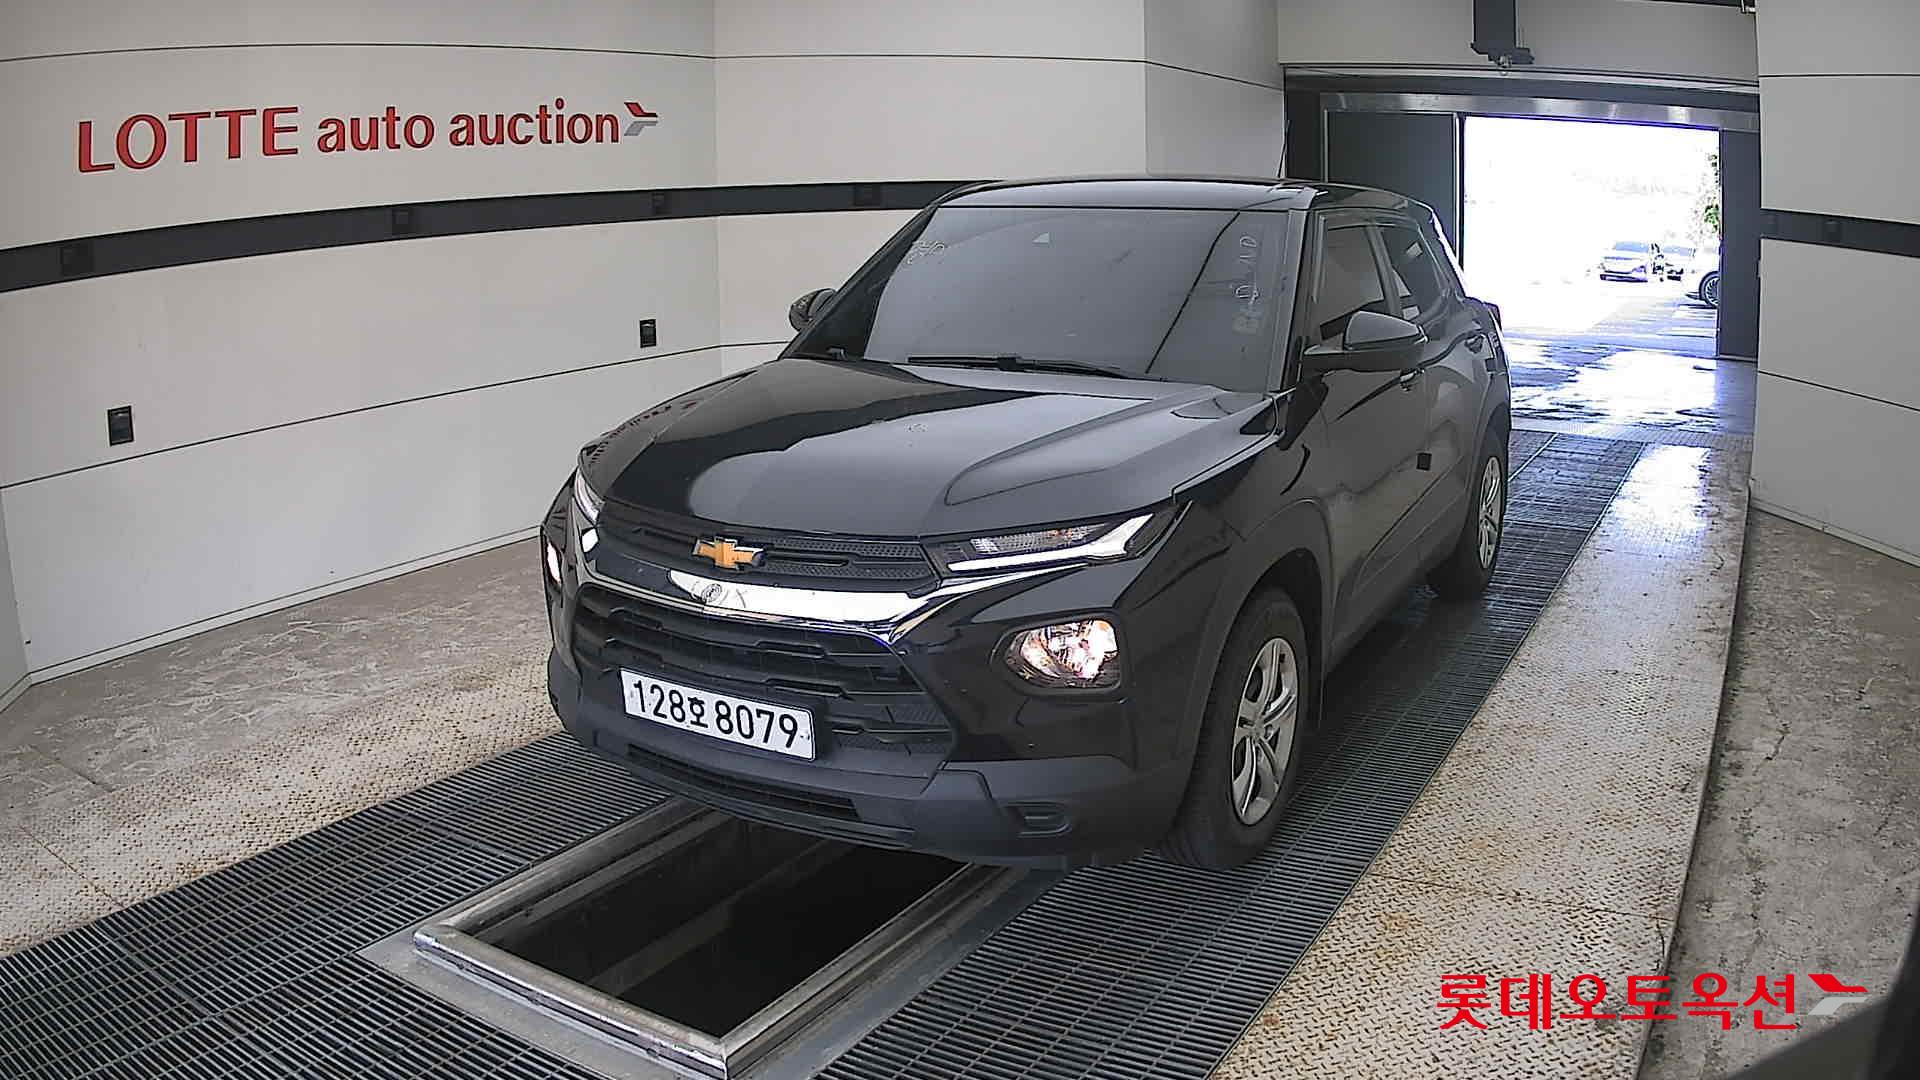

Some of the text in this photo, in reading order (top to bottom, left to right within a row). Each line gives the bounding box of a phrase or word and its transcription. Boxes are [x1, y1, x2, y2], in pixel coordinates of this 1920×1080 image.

[78, 97, 621, 173] LOTTE auto auction
